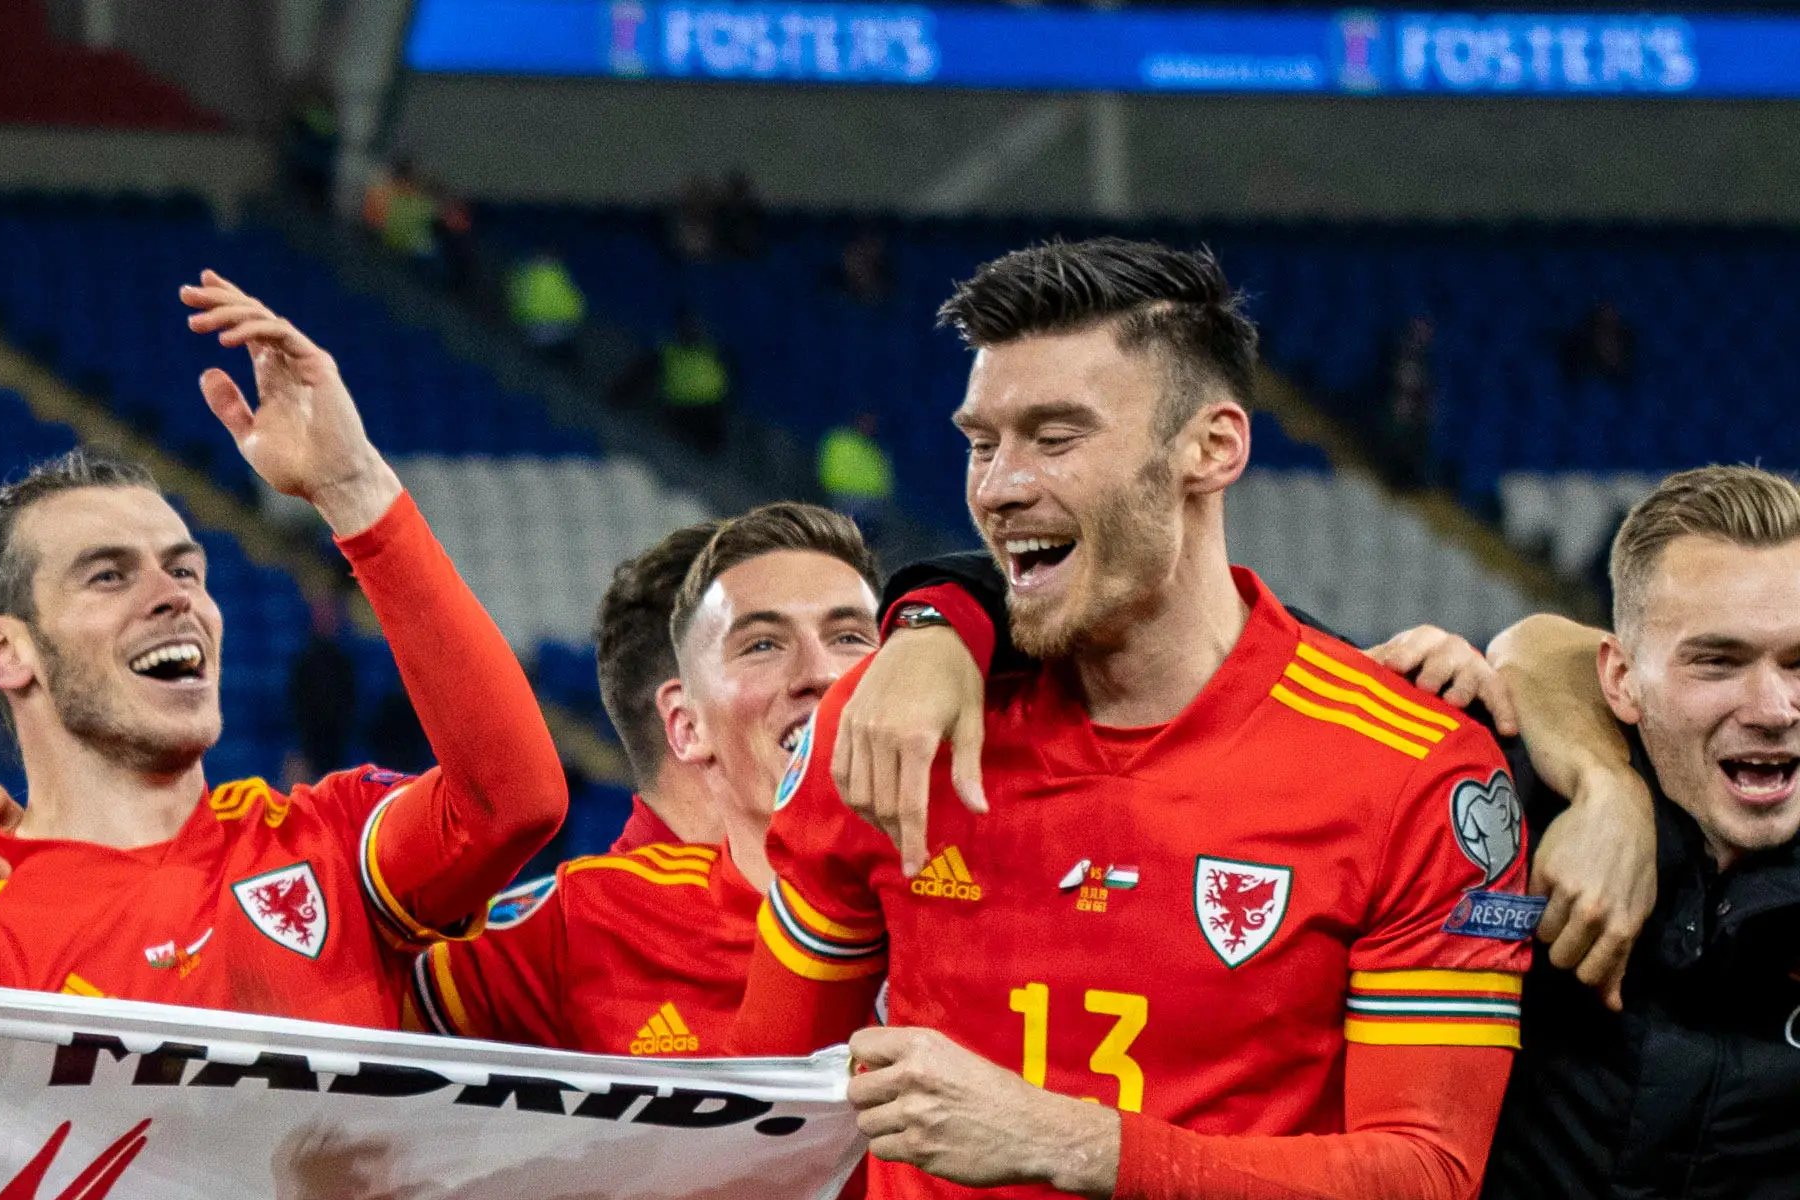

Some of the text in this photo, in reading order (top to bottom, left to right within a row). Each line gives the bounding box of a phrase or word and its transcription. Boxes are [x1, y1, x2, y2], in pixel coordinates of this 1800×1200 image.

[911, 877, 983, 901] adidas
[629, 1034, 699, 1056] adidas
[1009, 982, 1148, 1113] 13
